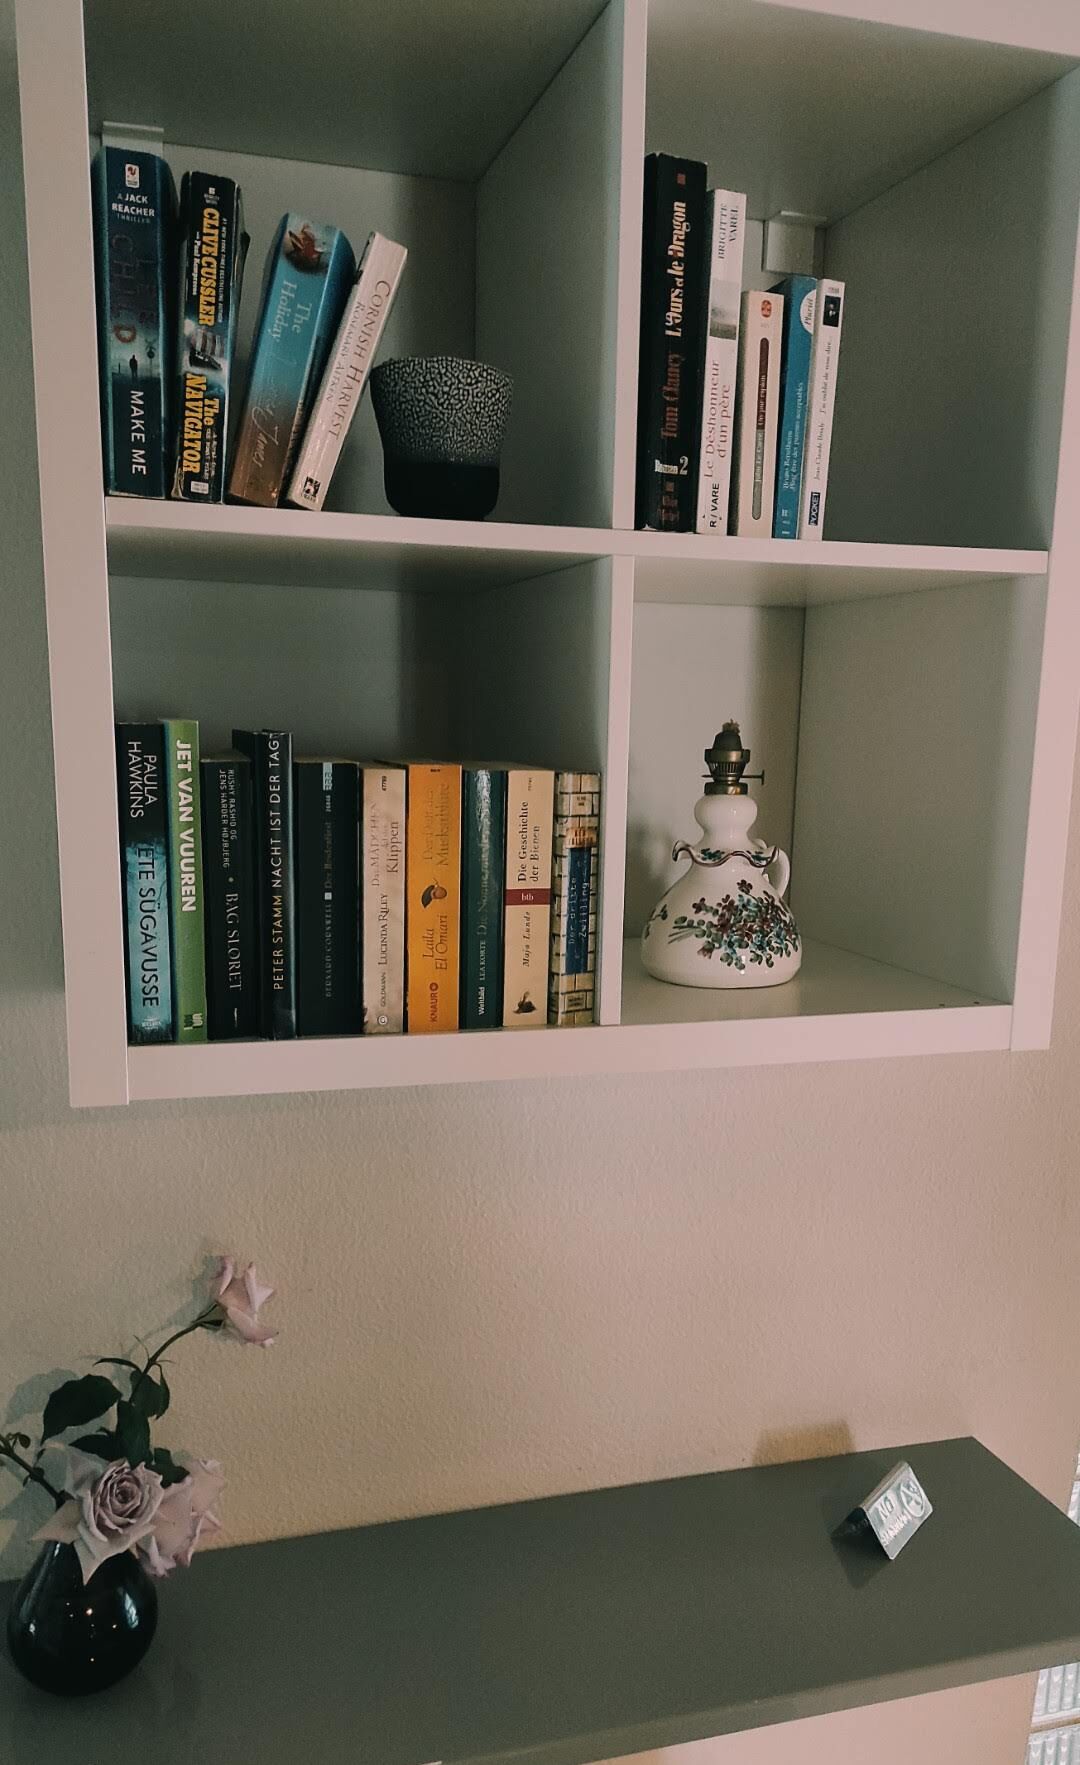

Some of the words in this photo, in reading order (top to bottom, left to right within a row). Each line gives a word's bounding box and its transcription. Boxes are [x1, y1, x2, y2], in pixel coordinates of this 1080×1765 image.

[112, 203, 155, 217] REACHER
[125, 194, 148, 204] JACK
[202, 208, 219, 256] CLIVE
[667, 201, 691, 258] Dragon
[718, 203, 727, 259] BRIGITTE
[667, 261, 684, 276] le
[198, 256, 217, 326] CUSSLER
[267, 280, 297, 343] Holiday
[291, 301, 313, 333] The
[352, 280, 392, 359] CORNISH
[660, 352, 685, 401] Clancy
[130, 390, 145, 443] MAKE
[203, 398, 219, 426] The
[328, 366, 365, 440] HARVEST
[718, 384, 732, 419] père
[183, 373, 206, 473] NAVIGATOR
[660, 407, 678, 438] Tom
[717, 424, 728, 458] d'un
[131, 449, 146, 475] ME
[679, 455, 689, 476] 2
[704, 461, 713, 478] Le
[176, 739, 192, 772] JET
[268, 740, 280, 768] TAG
[128, 741, 144, 818] HAWKINS
[143, 755, 158, 805] PAULA
[219, 769, 227, 790] JENS
[227, 769, 235, 795] RUSHY
[269, 775, 280, 803] DER
[178, 777, 193, 822] VAN
[220, 793, 228, 824] HARDER
[269, 810, 281, 831] IST
[519, 801, 529, 859] Geschichte
[386, 822, 401, 873] Klippen
[530, 825, 540, 861] Bienen
[179, 828, 197, 912] VUUREN
[270, 838, 282, 888] NACHT
[517, 864, 527, 882] Die
[530, 865, 539, 882] der
[225, 893, 240, 924] BAG
[272, 895, 283, 943] STAMM
[379, 893, 389, 921] RILEY
[435, 914, 448, 954] Omari
[523, 911, 531, 940] Lunde
[139, 887, 161, 1007] SÜGAVUSSE
[378, 925, 388, 965] LUCINDA
[422, 928, 435, 958] Laila
[522, 944, 532, 967] Maja
[273, 950, 284, 991] PETER
[435, 958, 448, 970] El
[429, 993, 439, 1022] KNAUR
